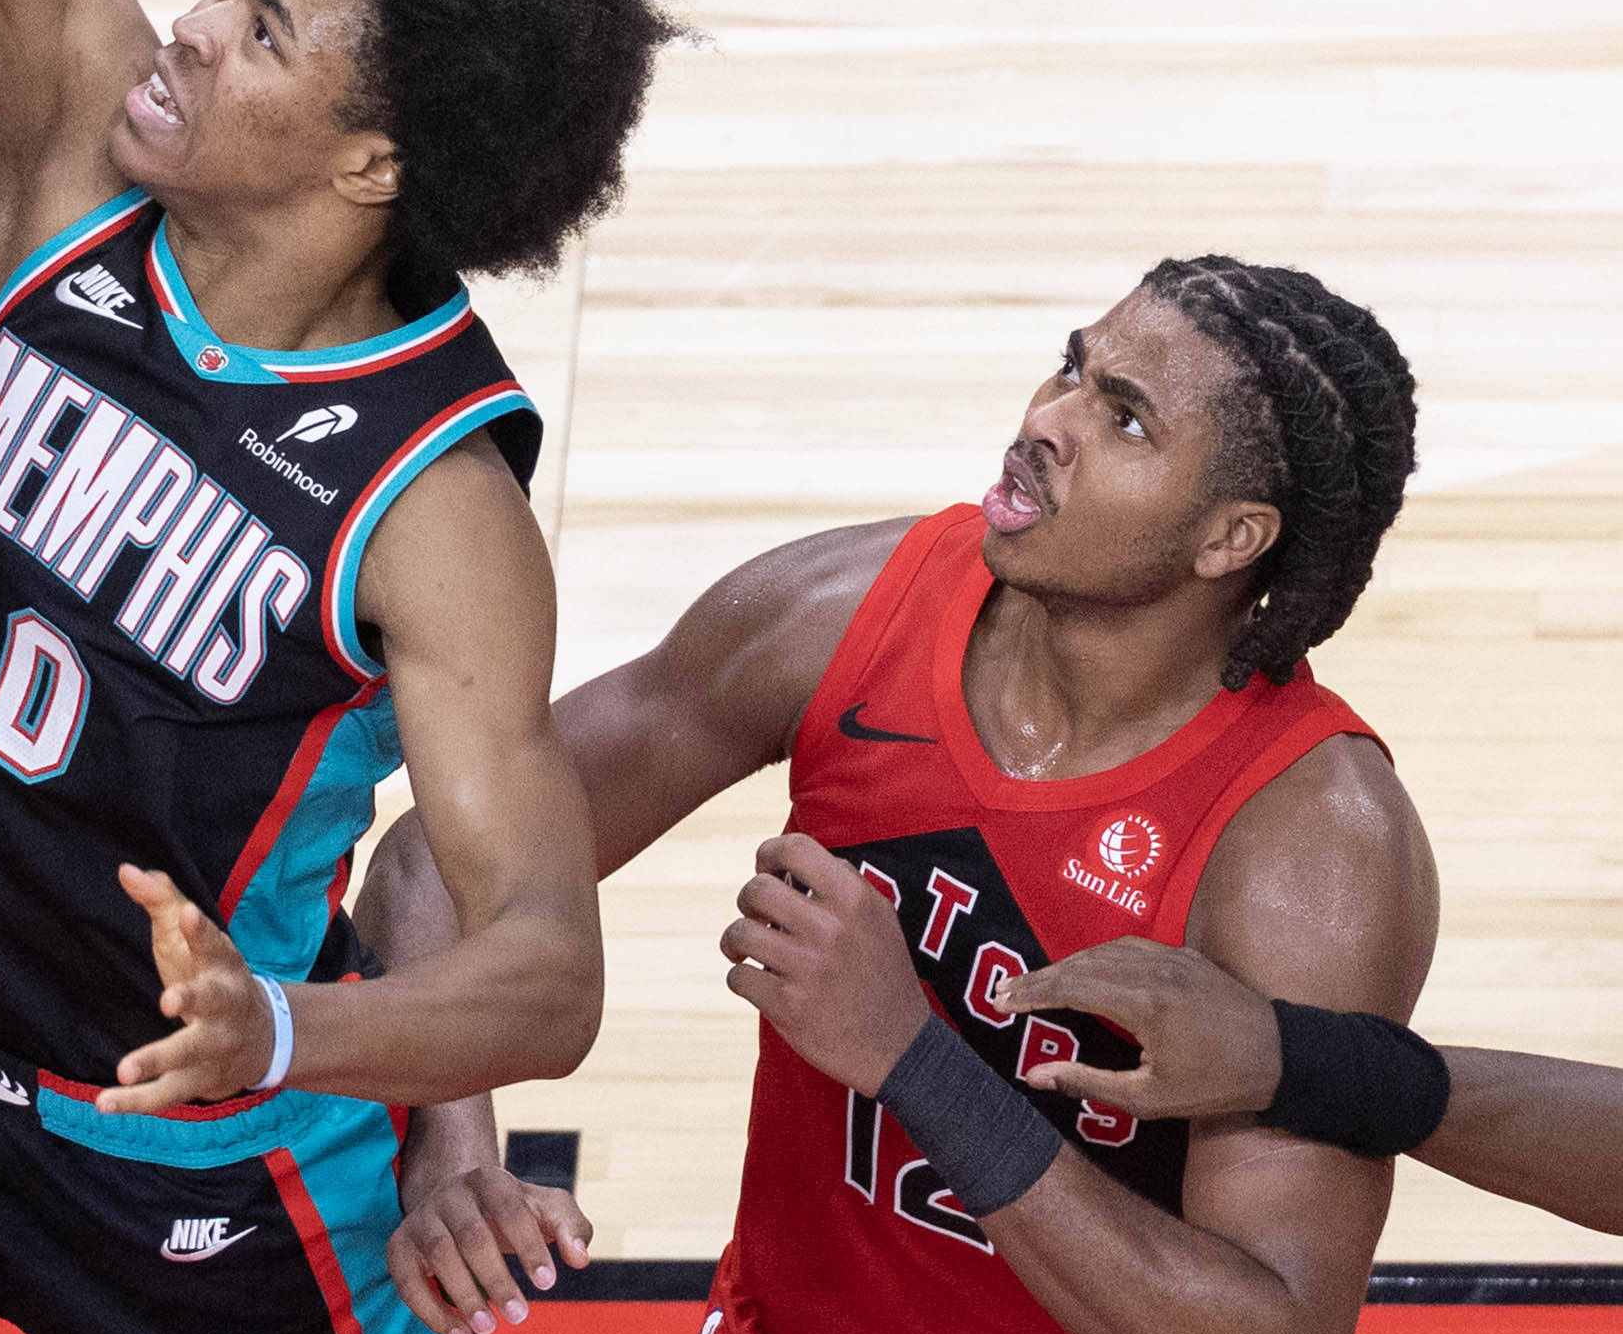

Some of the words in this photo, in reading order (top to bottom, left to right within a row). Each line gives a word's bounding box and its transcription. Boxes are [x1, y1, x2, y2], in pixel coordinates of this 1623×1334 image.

[73, 264, 136, 316] NIKE
[238, 428, 340, 506] Robinhood
[1063, 858, 1104, 895] Sun
[1106, 882, 1146, 916] Life
[170, 1217, 228, 1250] NIKE
